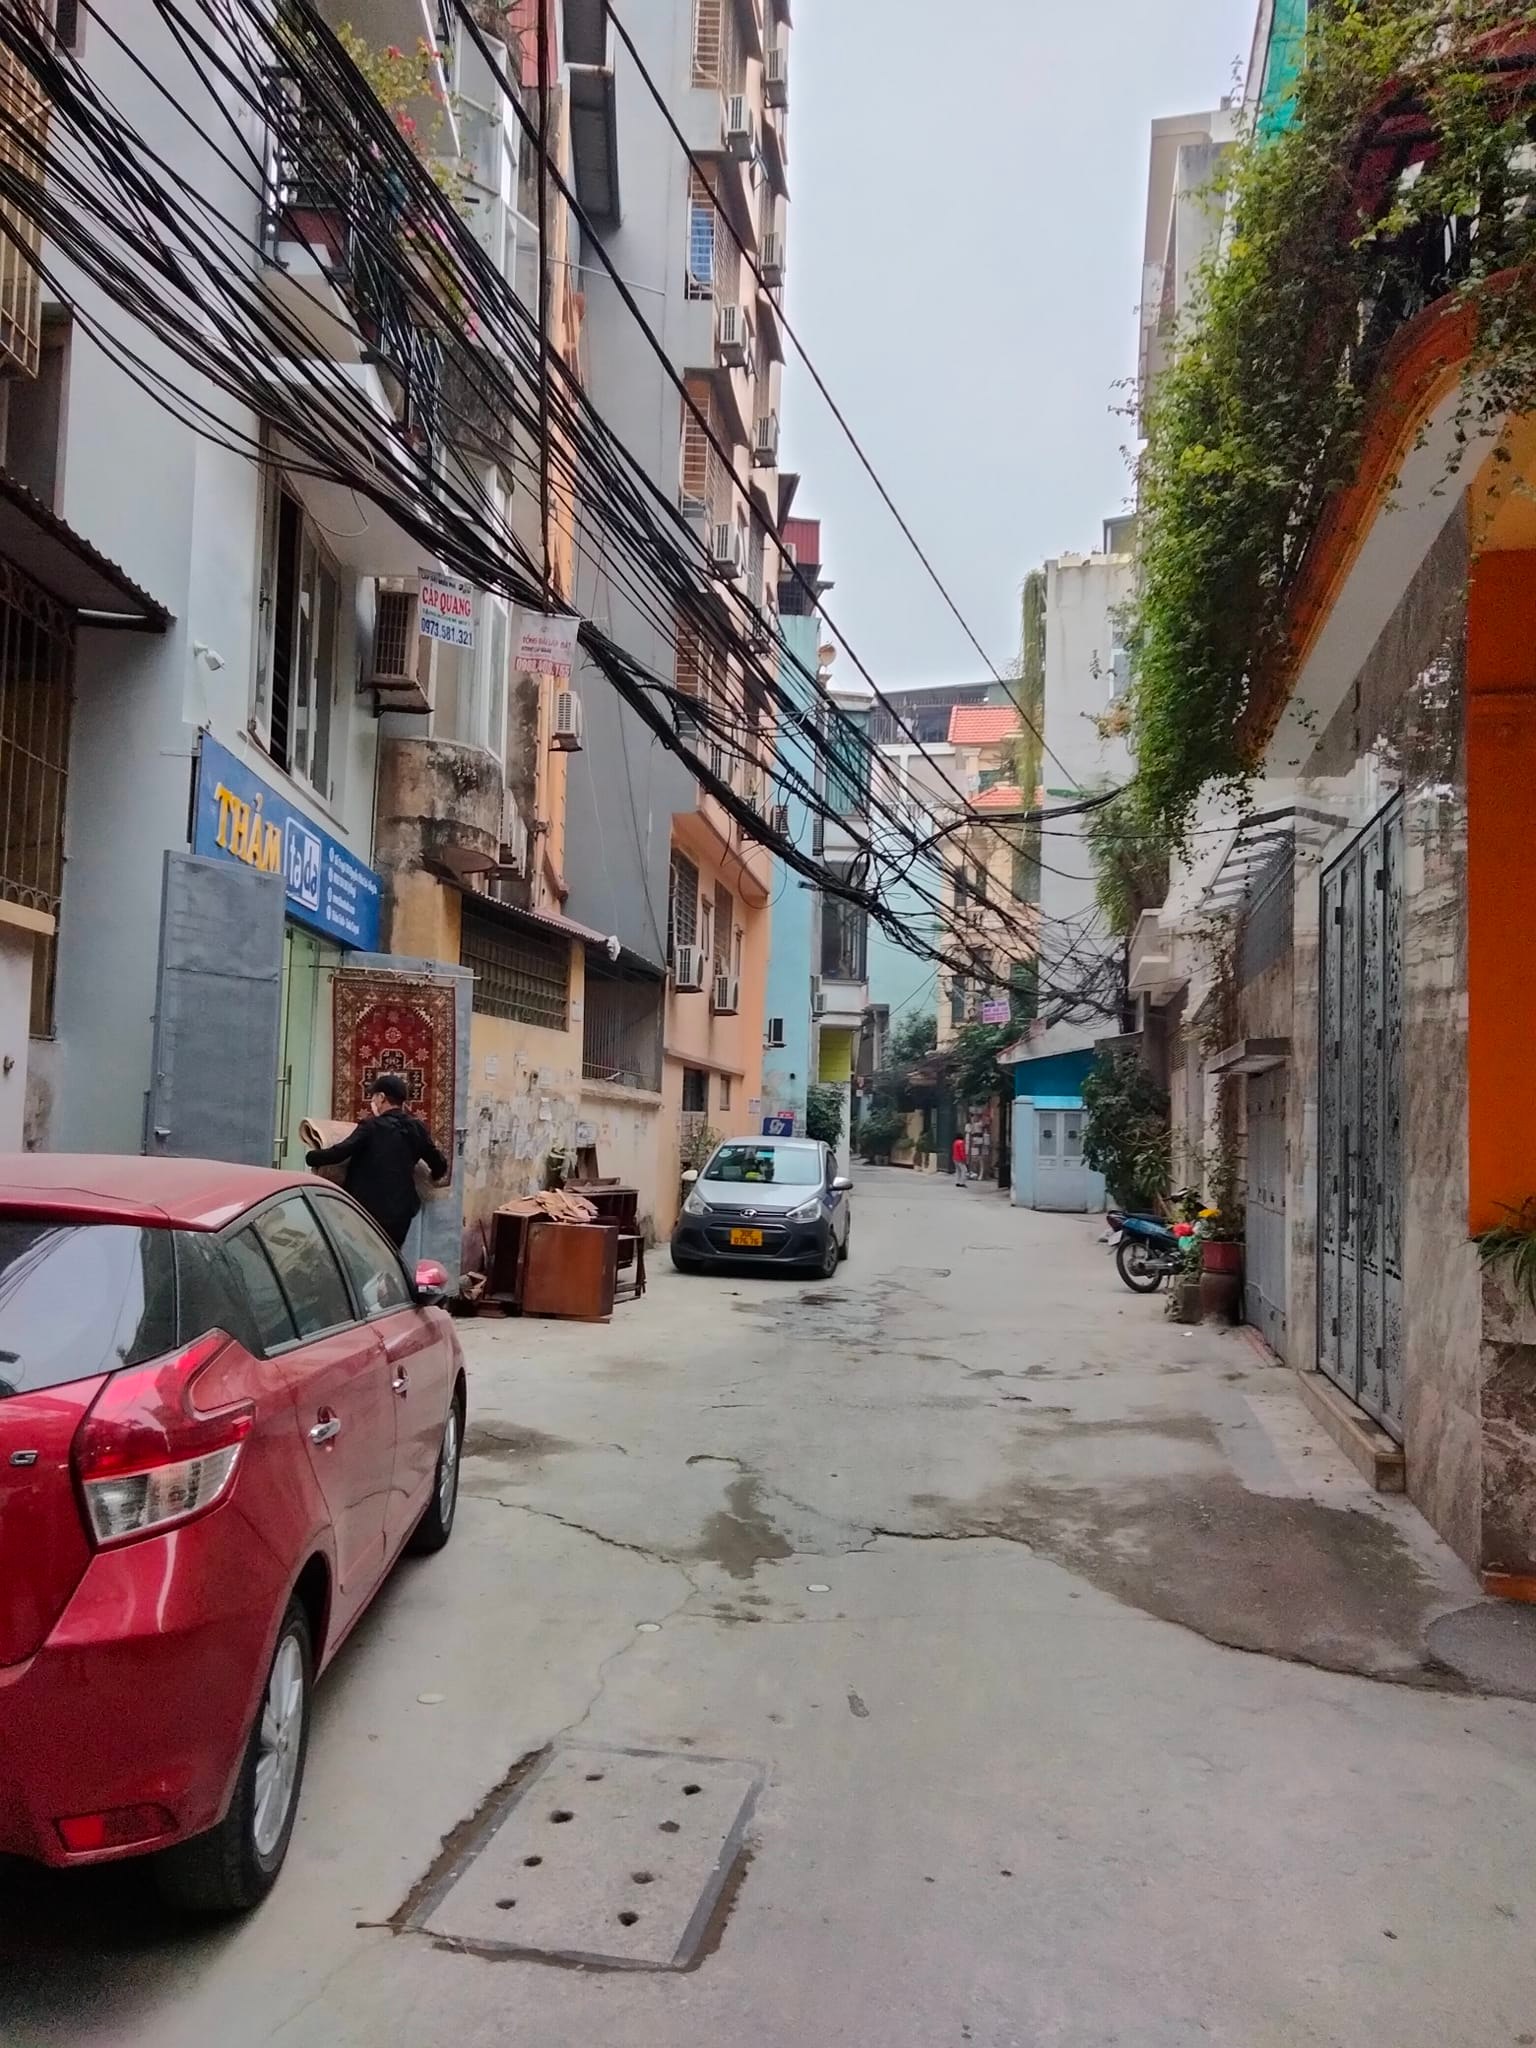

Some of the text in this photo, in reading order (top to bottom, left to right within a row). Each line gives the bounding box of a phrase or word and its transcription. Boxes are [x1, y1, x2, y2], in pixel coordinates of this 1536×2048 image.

[440, 593, 471, 617] QUANG
[421, 617, 472, 646] 0973.581.321
[214, 782, 282, 875] THẢM
[289, 835, 318, 897] tada
[9, 1449, 38, 1465] G
